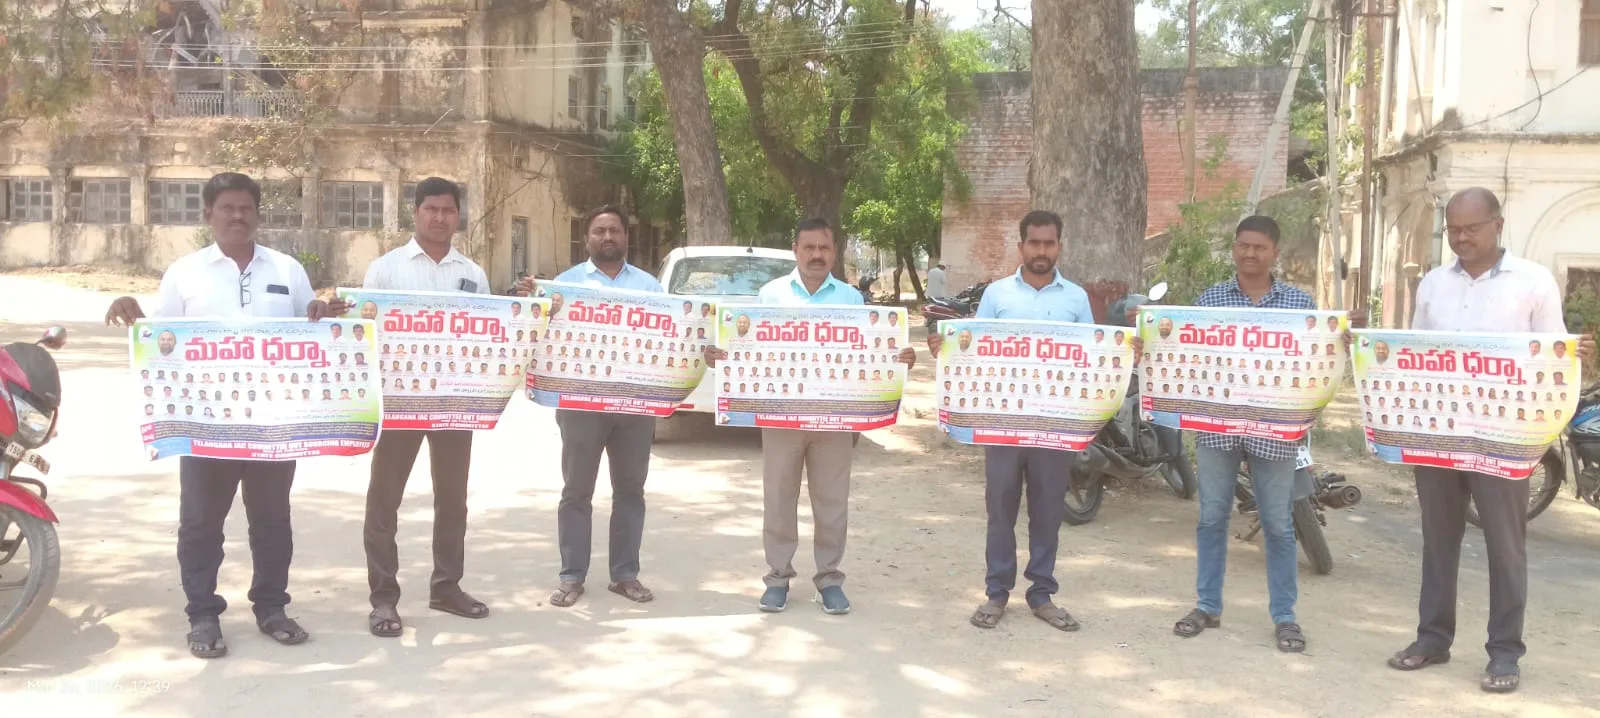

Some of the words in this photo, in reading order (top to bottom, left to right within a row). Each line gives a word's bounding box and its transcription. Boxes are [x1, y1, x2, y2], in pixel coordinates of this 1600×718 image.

[384, 309, 445, 334] మహా
[449, 311, 509, 343] ధర్నా
[568, 301, 623, 326] మహా
[626, 305, 679, 338] ధర్నా
[756, 321, 809, 342] మహా
[814, 321, 867, 350] ధర్నా
[184, 336, 254, 361] మహా
[261, 336, 331, 368] ధర్నా
[977, 336, 1031, 358] మహా
[1036, 337, 1091, 369] ధర్నా
[1179, 323, 1238, 347] మహా
[1242, 325, 1302, 357] ధర్నా
[1396, 348, 1456, 373] మహా
[1462, 351, 1527, 386] ధర్నా
